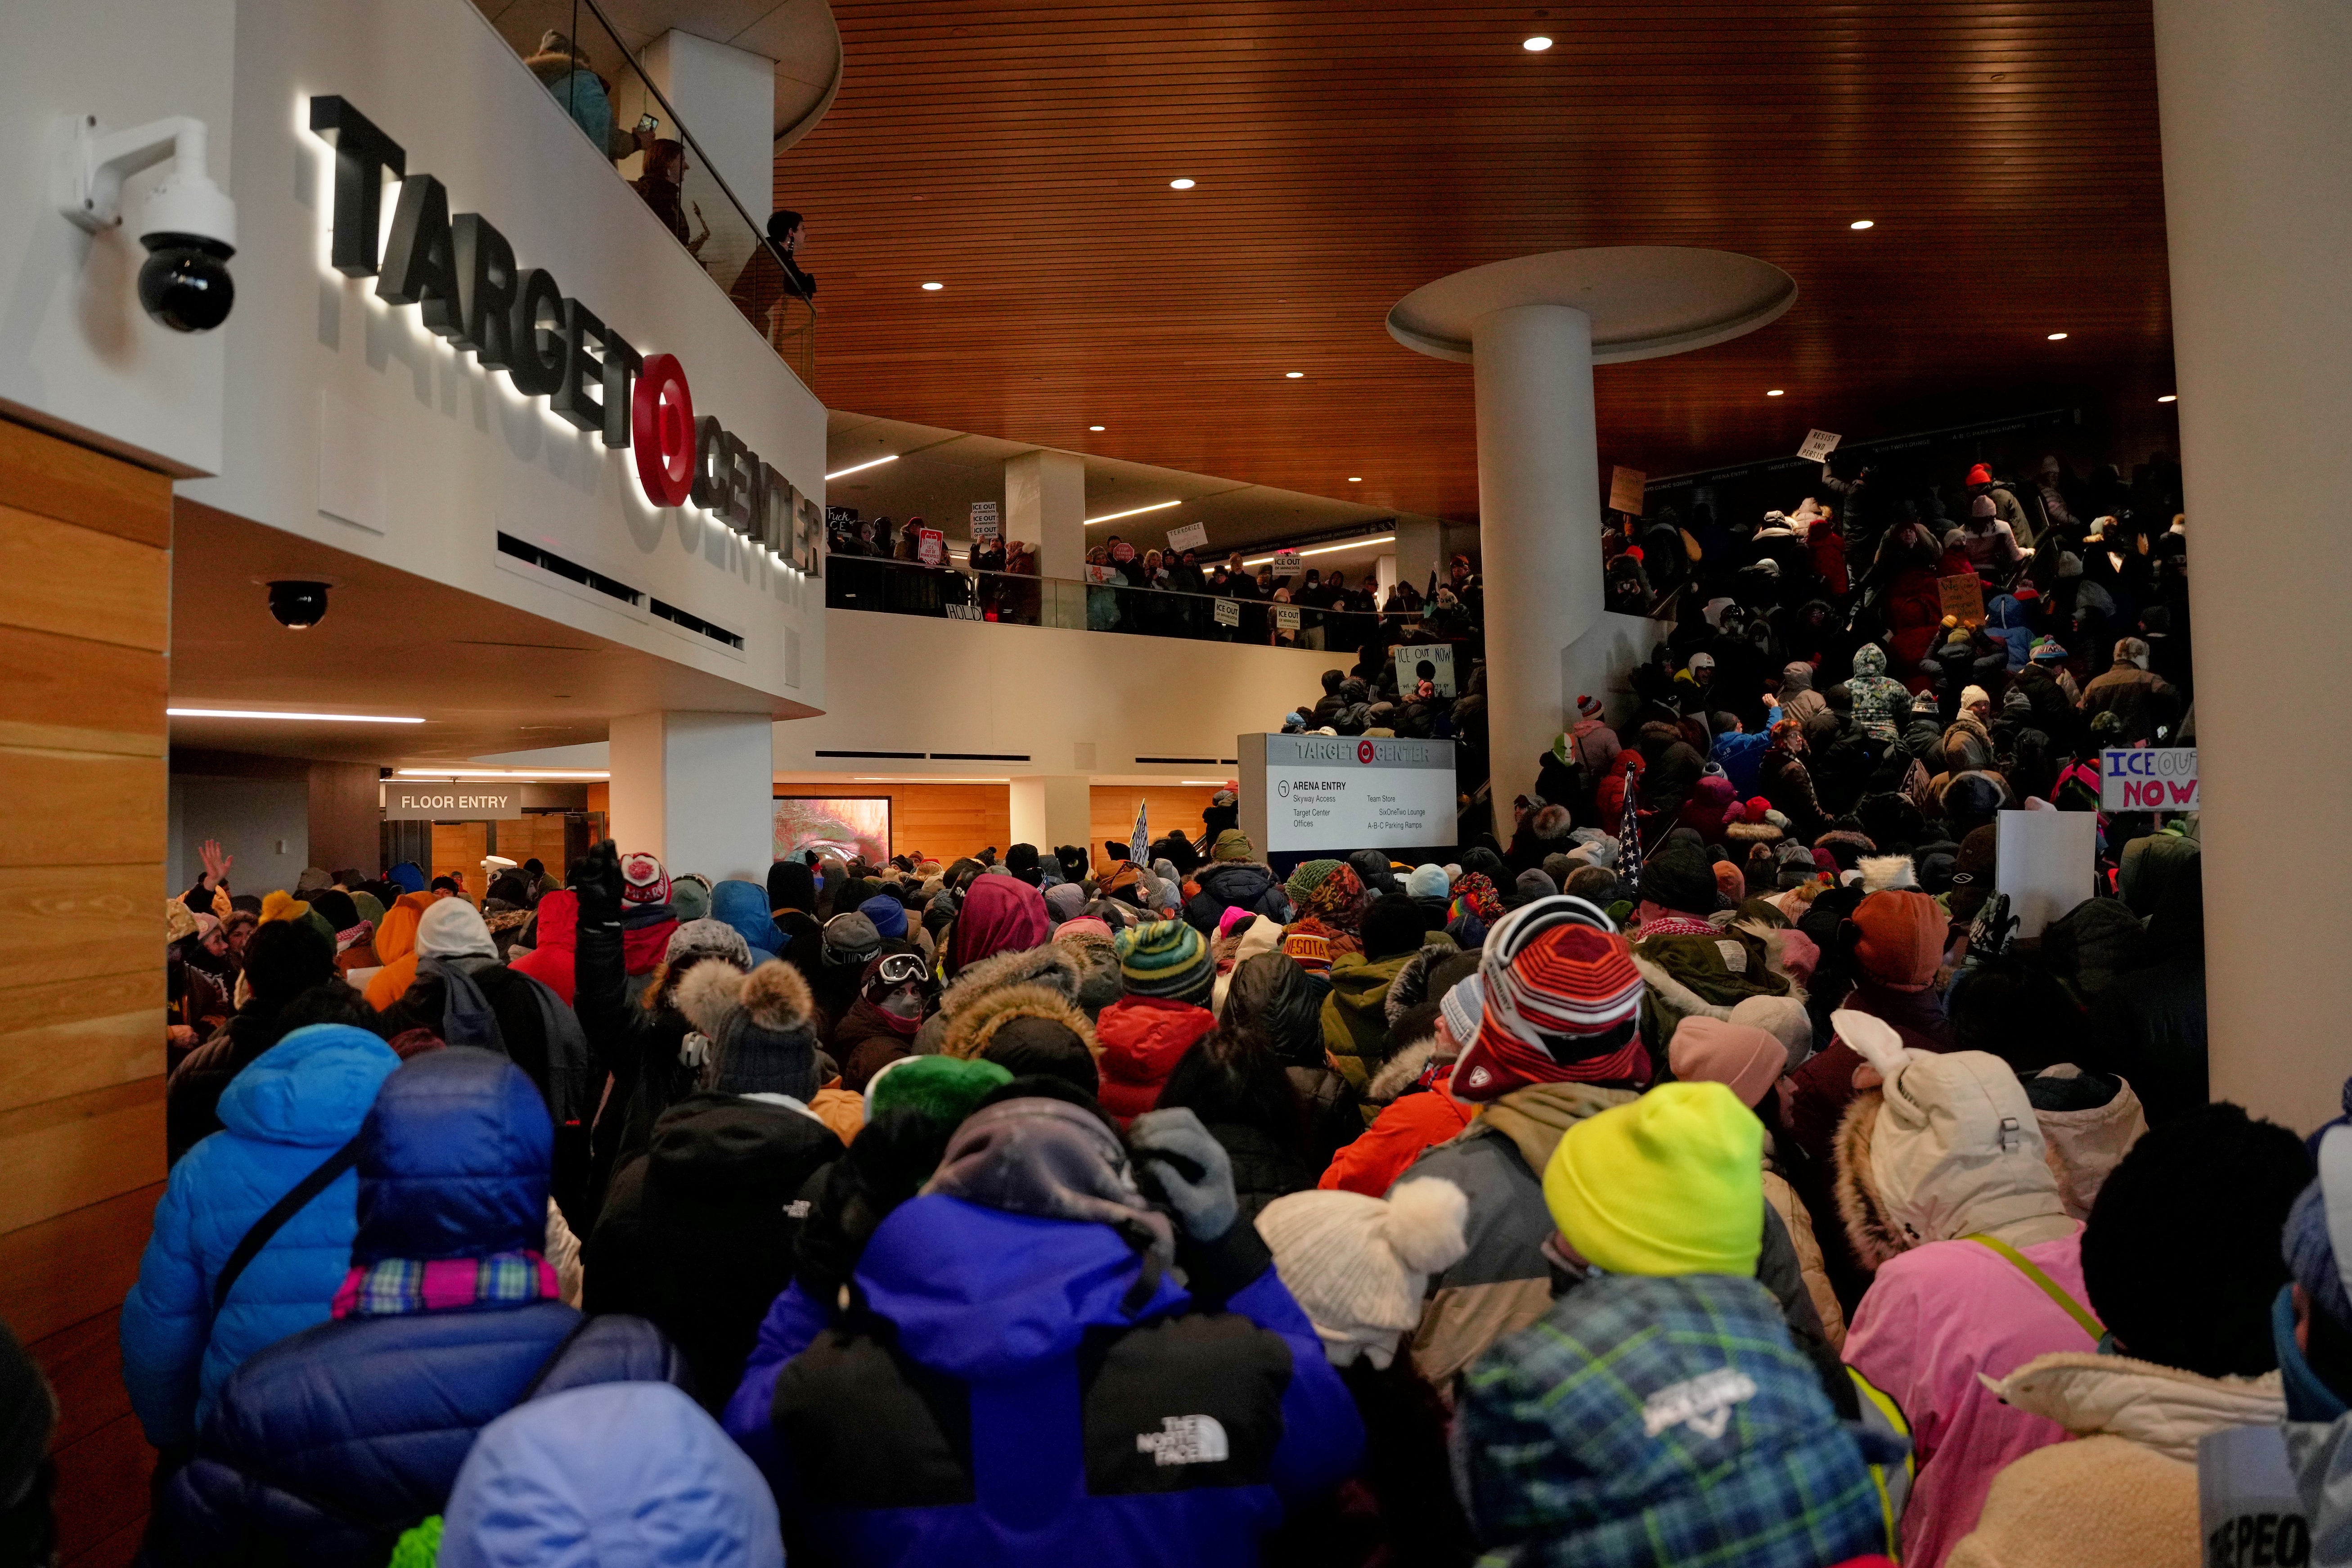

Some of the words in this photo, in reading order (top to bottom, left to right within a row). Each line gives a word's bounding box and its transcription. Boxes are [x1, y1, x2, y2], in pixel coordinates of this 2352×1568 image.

[310, 95, 644, 449] TARGET
[689, 415, 823, 579] CENTER
[1812, 432, 1835, 442] RESIST
[1813, 442, 1825, 450] AND
[1905, 439, 1930, 448] LOUNGE
[1801, 449, 1825, 460] PERSIS
[1731, 470, 1748, 478] ENTRY
[826, 507, 850, 521] Fuck
[1169, 524, 1201, 536] TERRORIZE
[1300, 535, 1321, 543] COURTSIDE
[948, 605, 981, 621] HOLD
[1216, 604, 1225, 612] ICE
[1226, 607, 1238, 615] OUT
[1397, 648, 1411, 663] ICE
[1415, 648, 1429, 659] OUT
[1435, 647, 1451, 663] NOW
[1295, 742, 1358, 760] TARGET
[1375, 745, 1430, 762] CENTER
[2106, 752, 2155, 777] ICE
[1293, 782, 1319, 791] ARENA
[1322, 782, 1346, 791] ENTRY
[401, 795, 454, 809] FLOOR
[458, 795, 508, 809] ENTRY
[1293, 795, 1315, 803] Skyway
[1294, 809, 1310, 818] Target
[1408, 809, 1426, 817] Lounge
[1385, 821, 1403, 830] Parking
[1405, 821, 1422, 830] Ramps
[1284, 939, 1326, 957] NESOTA
